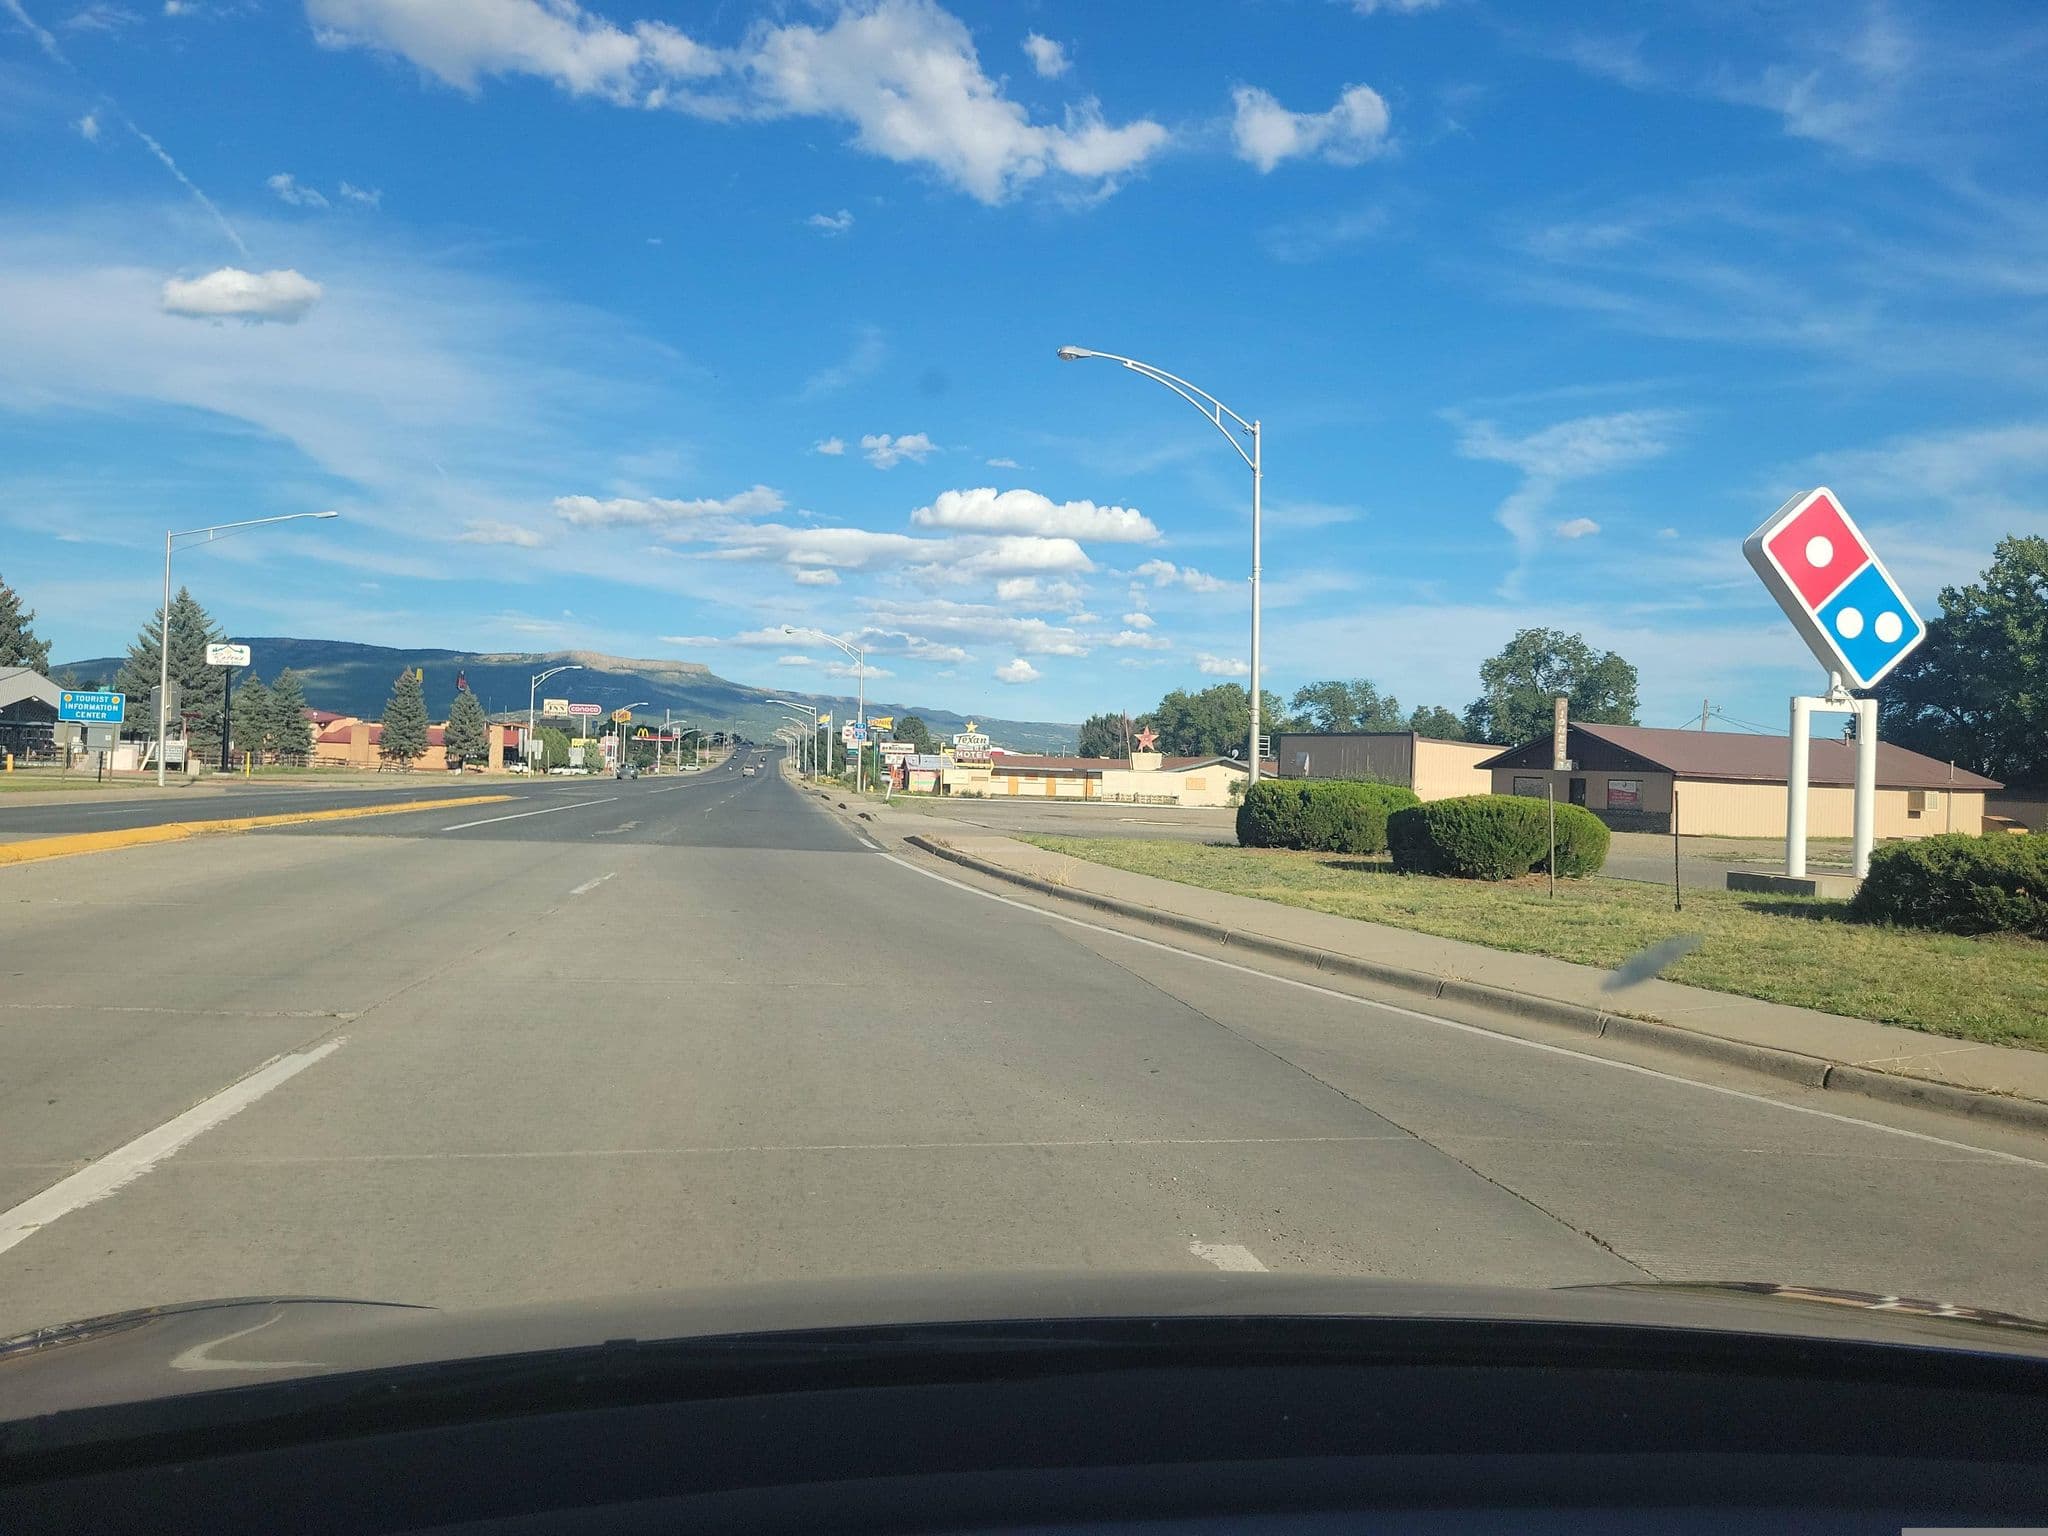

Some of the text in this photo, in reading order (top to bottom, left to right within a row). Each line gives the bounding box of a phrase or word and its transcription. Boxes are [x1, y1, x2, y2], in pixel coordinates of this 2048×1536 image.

[75, 695, 109, 703] TOURIST
[65, 703, 119, 711] INFORMATION
[75, 711, 107, 719] CENTER
[956, 734, 987, 745] Texan
[956, 751, 991, 759] MOTEL
